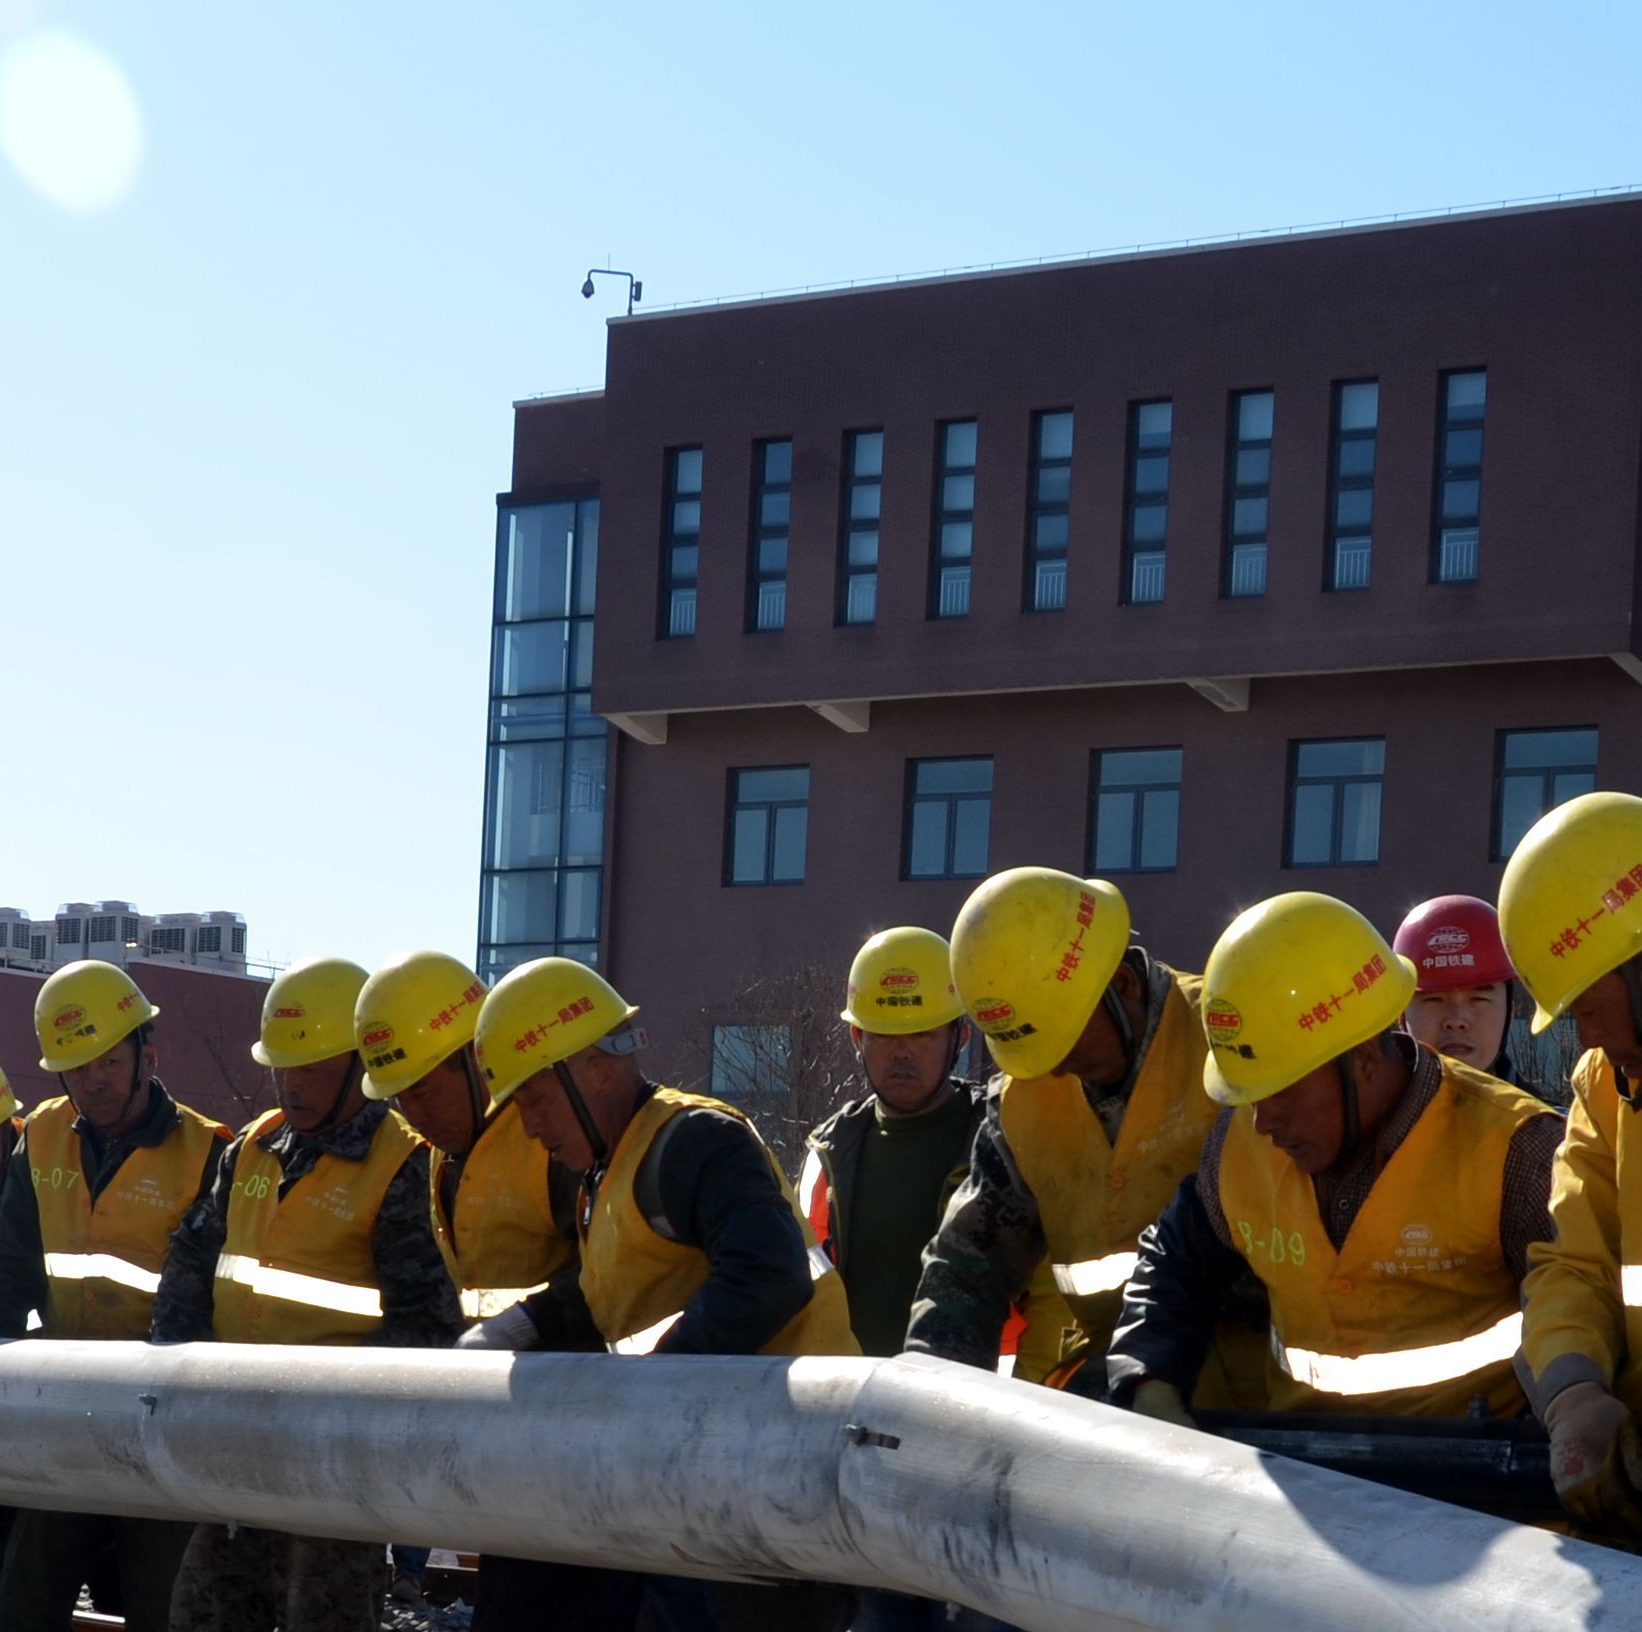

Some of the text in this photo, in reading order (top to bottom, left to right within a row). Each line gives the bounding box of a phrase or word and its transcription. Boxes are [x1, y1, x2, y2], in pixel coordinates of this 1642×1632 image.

[1055, 891, 1096, 982] 中铁十一局集团
[1423, 954, 1475, 969] 中国铁建
[875, 995, 923, 1008] 中国铁建
[1298, 954, 1387, 1032] 中铁十一局集团
[515, 996, 595, 1052] 中铁十一局集团
